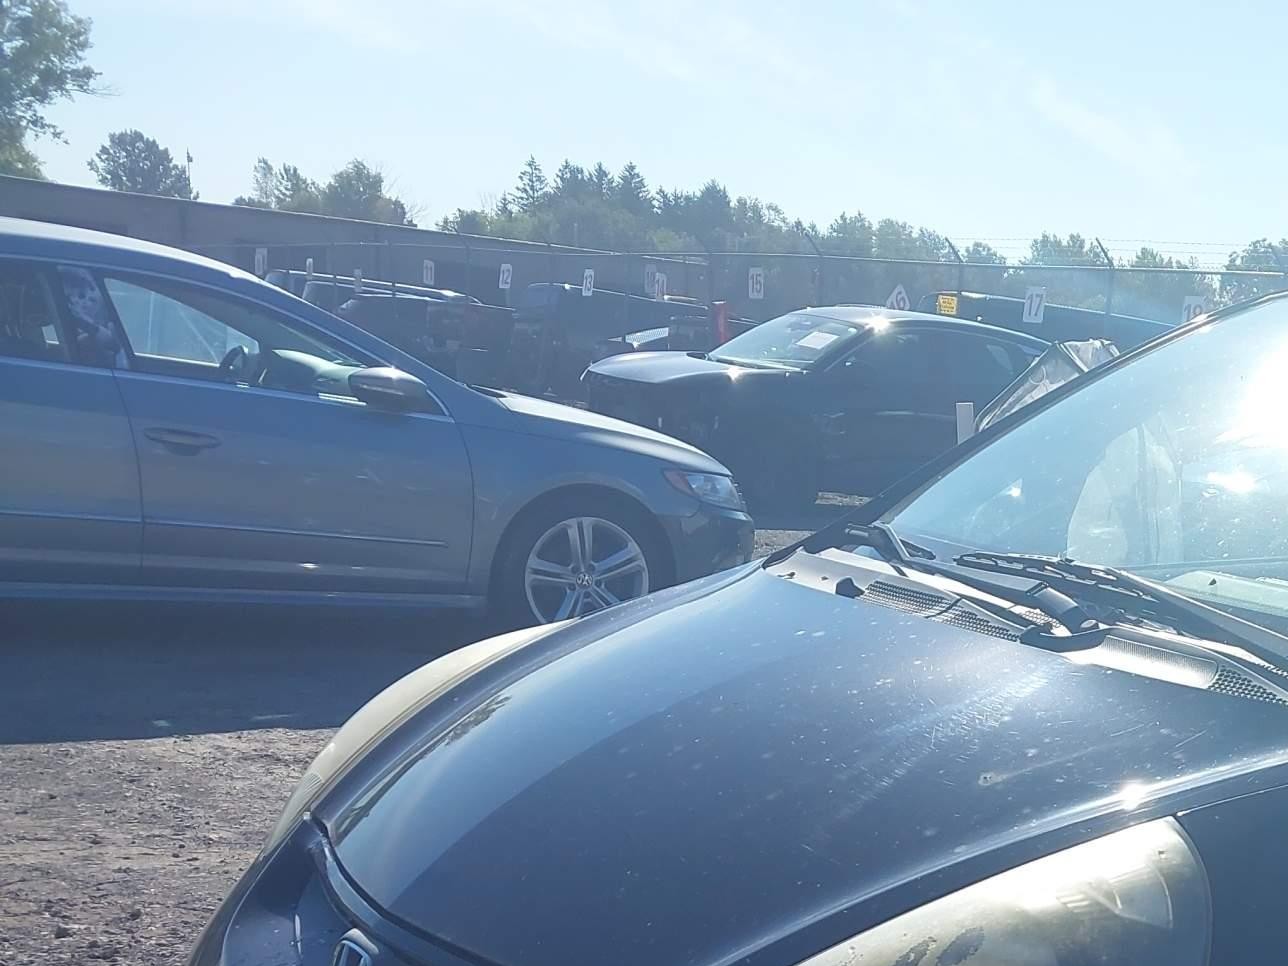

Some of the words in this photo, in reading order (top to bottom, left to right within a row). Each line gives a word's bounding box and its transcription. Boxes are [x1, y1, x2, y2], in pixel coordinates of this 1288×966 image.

[501, 268, 511, 285] 12
[583, 273, 594, 292] 13
[751, 272, 762, 294] 15
[1027, 292, 1044, 317] 17
